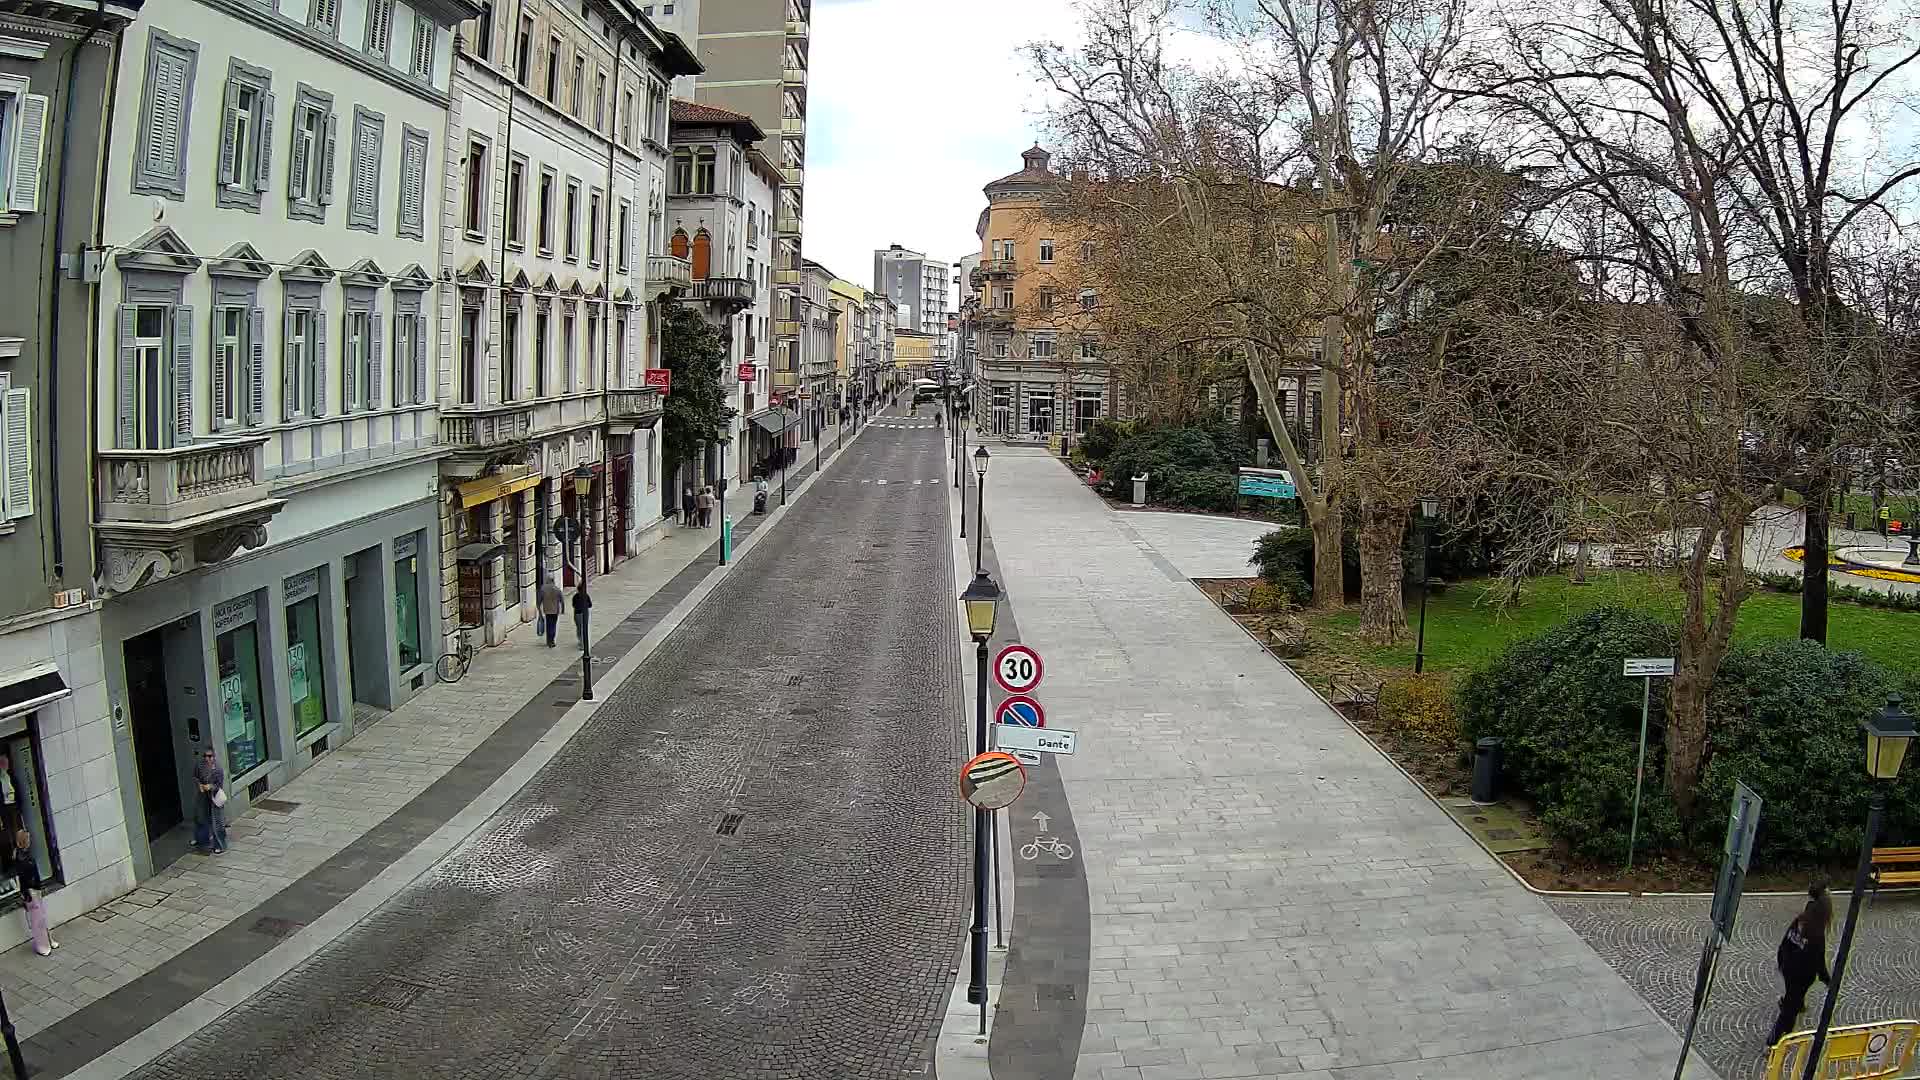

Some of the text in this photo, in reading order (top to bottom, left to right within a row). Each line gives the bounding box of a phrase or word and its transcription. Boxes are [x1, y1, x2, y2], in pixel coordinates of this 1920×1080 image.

[1005, 658, 1033, 681] 30
[222, 677, 240, 701] 130
[1038, 738, 1070, 750] Dante
